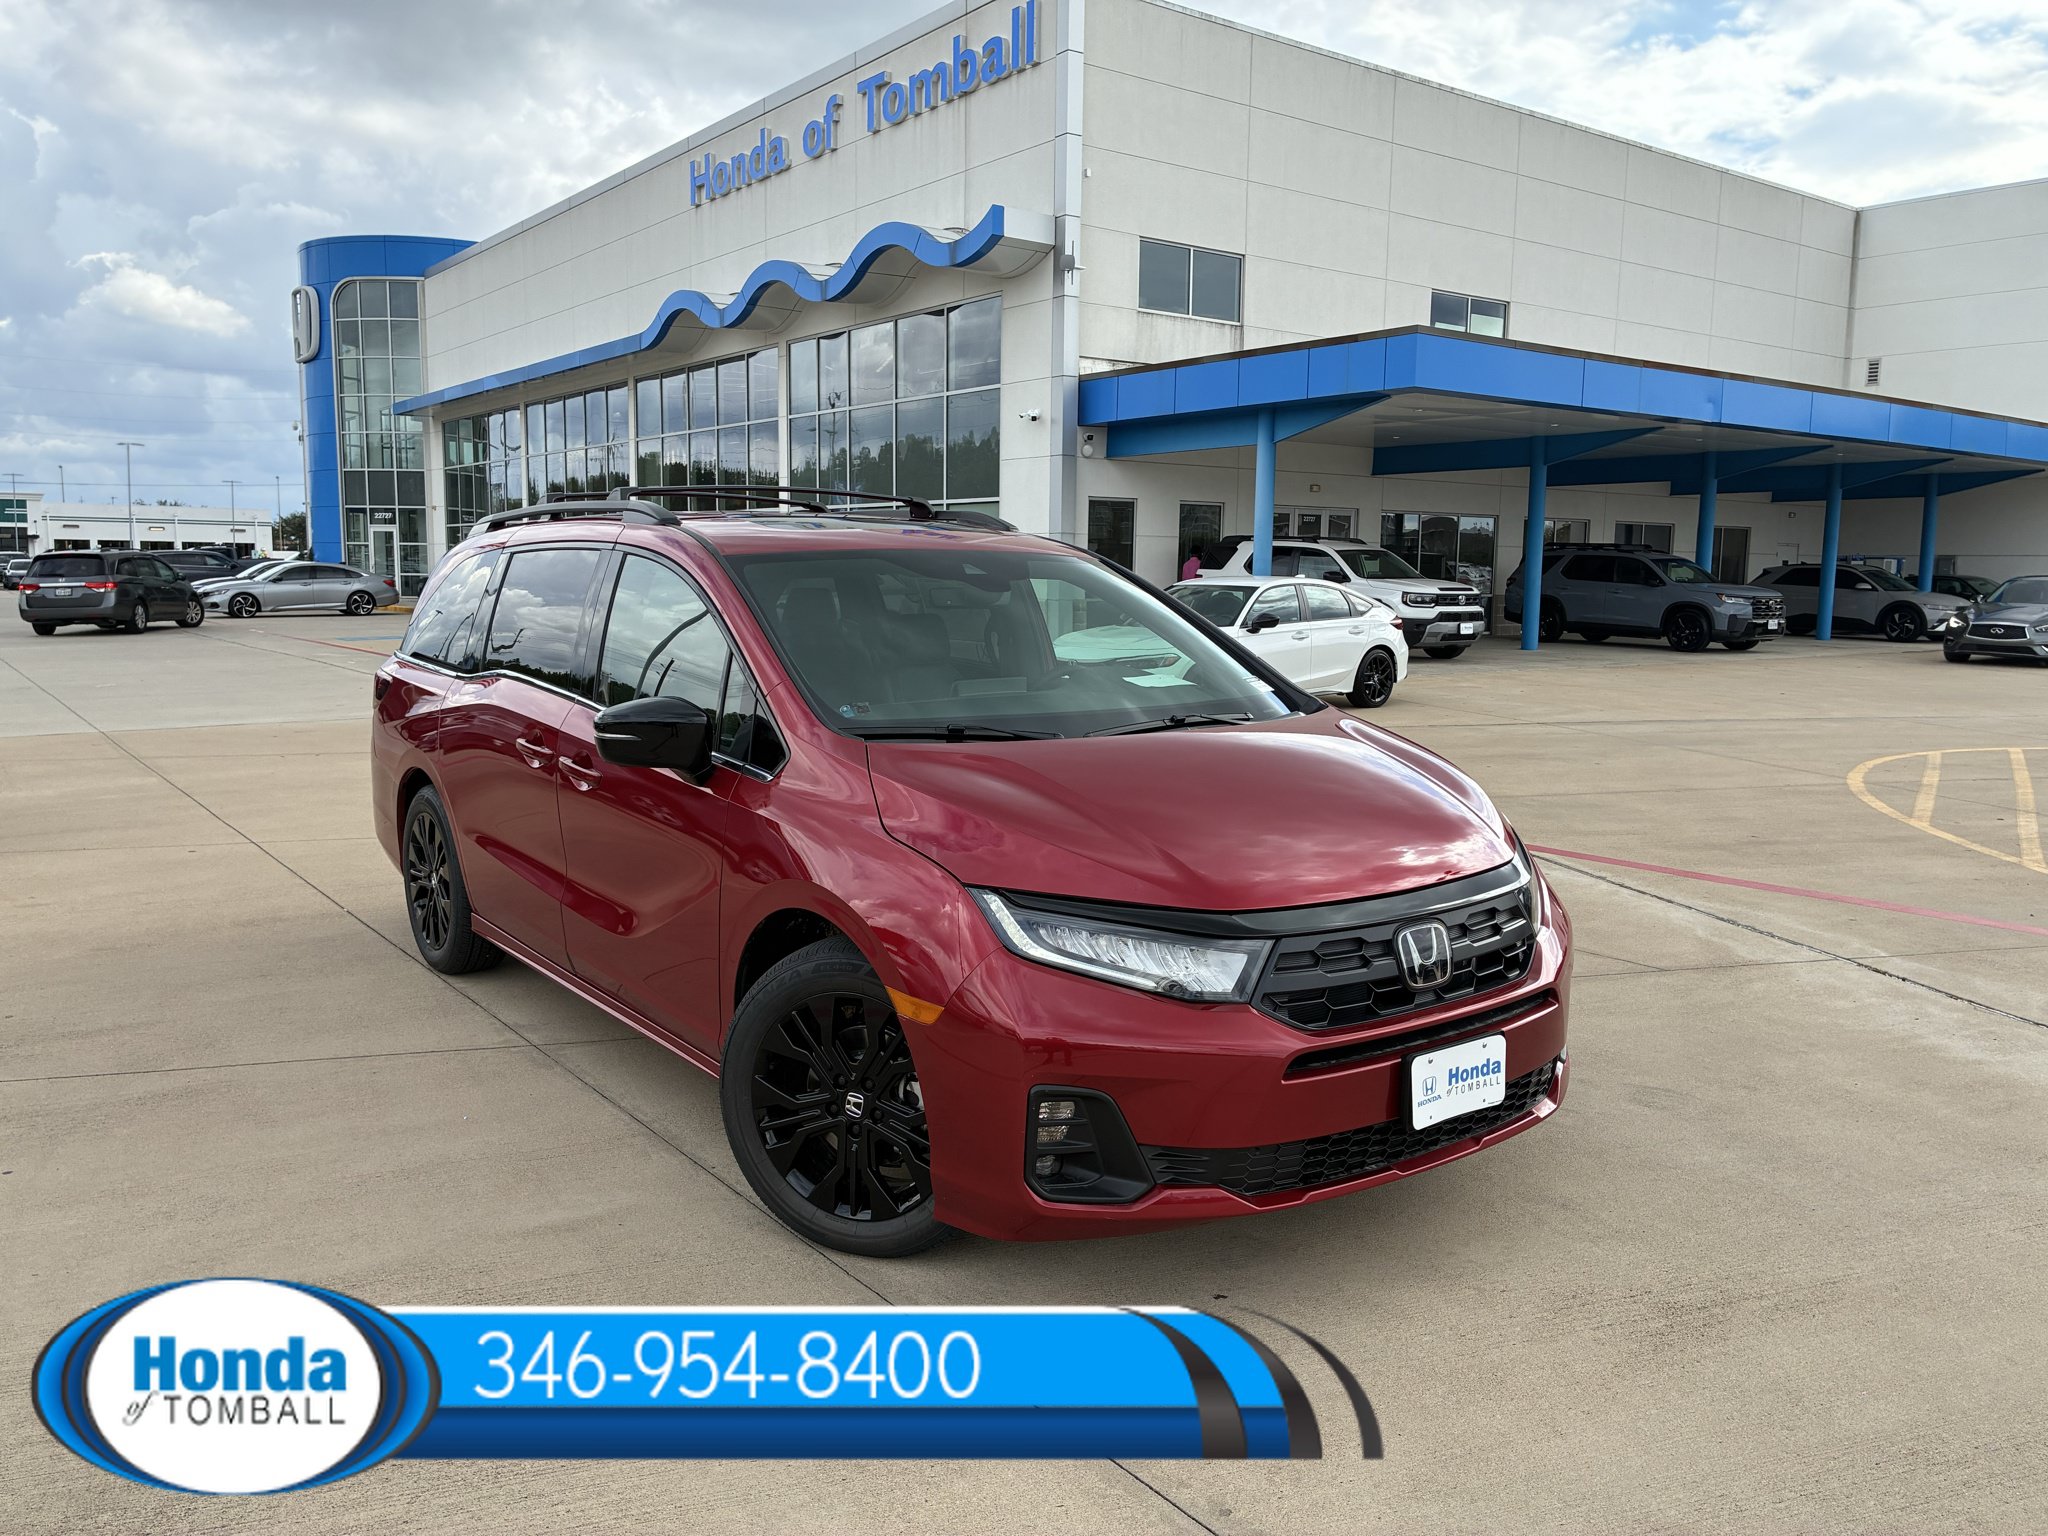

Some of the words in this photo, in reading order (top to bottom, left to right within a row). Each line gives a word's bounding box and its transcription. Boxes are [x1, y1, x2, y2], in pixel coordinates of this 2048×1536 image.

[689, 127, 792, 207] Honda
[803, 93, 843, 159] of
[857, 0, 1041, 134] Tomball
[1448, 1058, 1501, 1087] Honda
[1446, 1084, 1455, 1098] of
[1455, 1075, 1501, 1095] TOMBALL
[1417, 1094, 1442, 1108] HONDA
